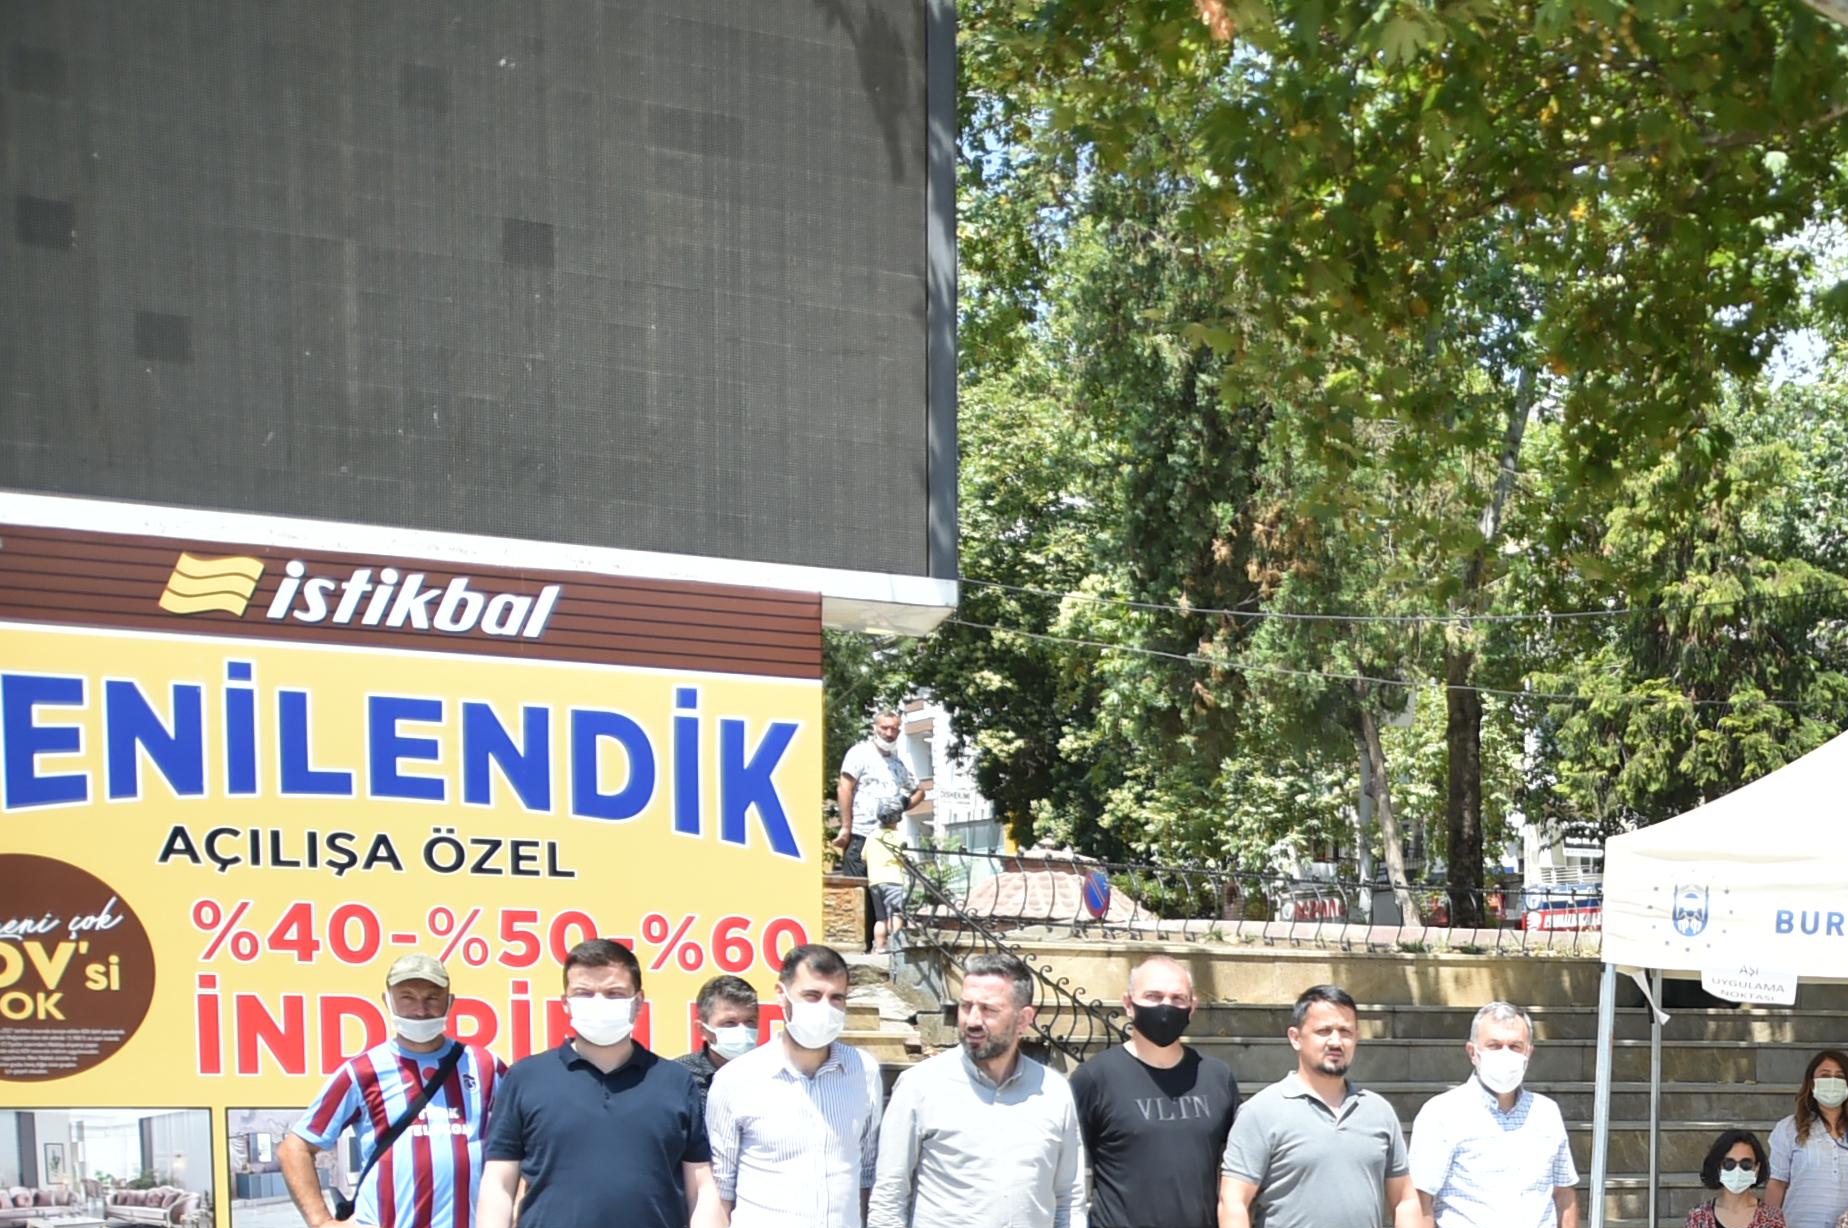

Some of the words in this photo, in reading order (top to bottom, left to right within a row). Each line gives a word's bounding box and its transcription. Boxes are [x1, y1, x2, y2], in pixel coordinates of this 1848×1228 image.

[266, 559, 561, 639] istikbal
[1, 660, 802, 858] ENİLENDİK
[158, 824, 404, 877] AÇILIŞA
[422, 826, 577, 879] ÖZEL
[68, 895, 125, 941] çok
[1711, 976, 1786, 994] UYGULAMA
[1134, 1094, 1212, 1121] VLTN
